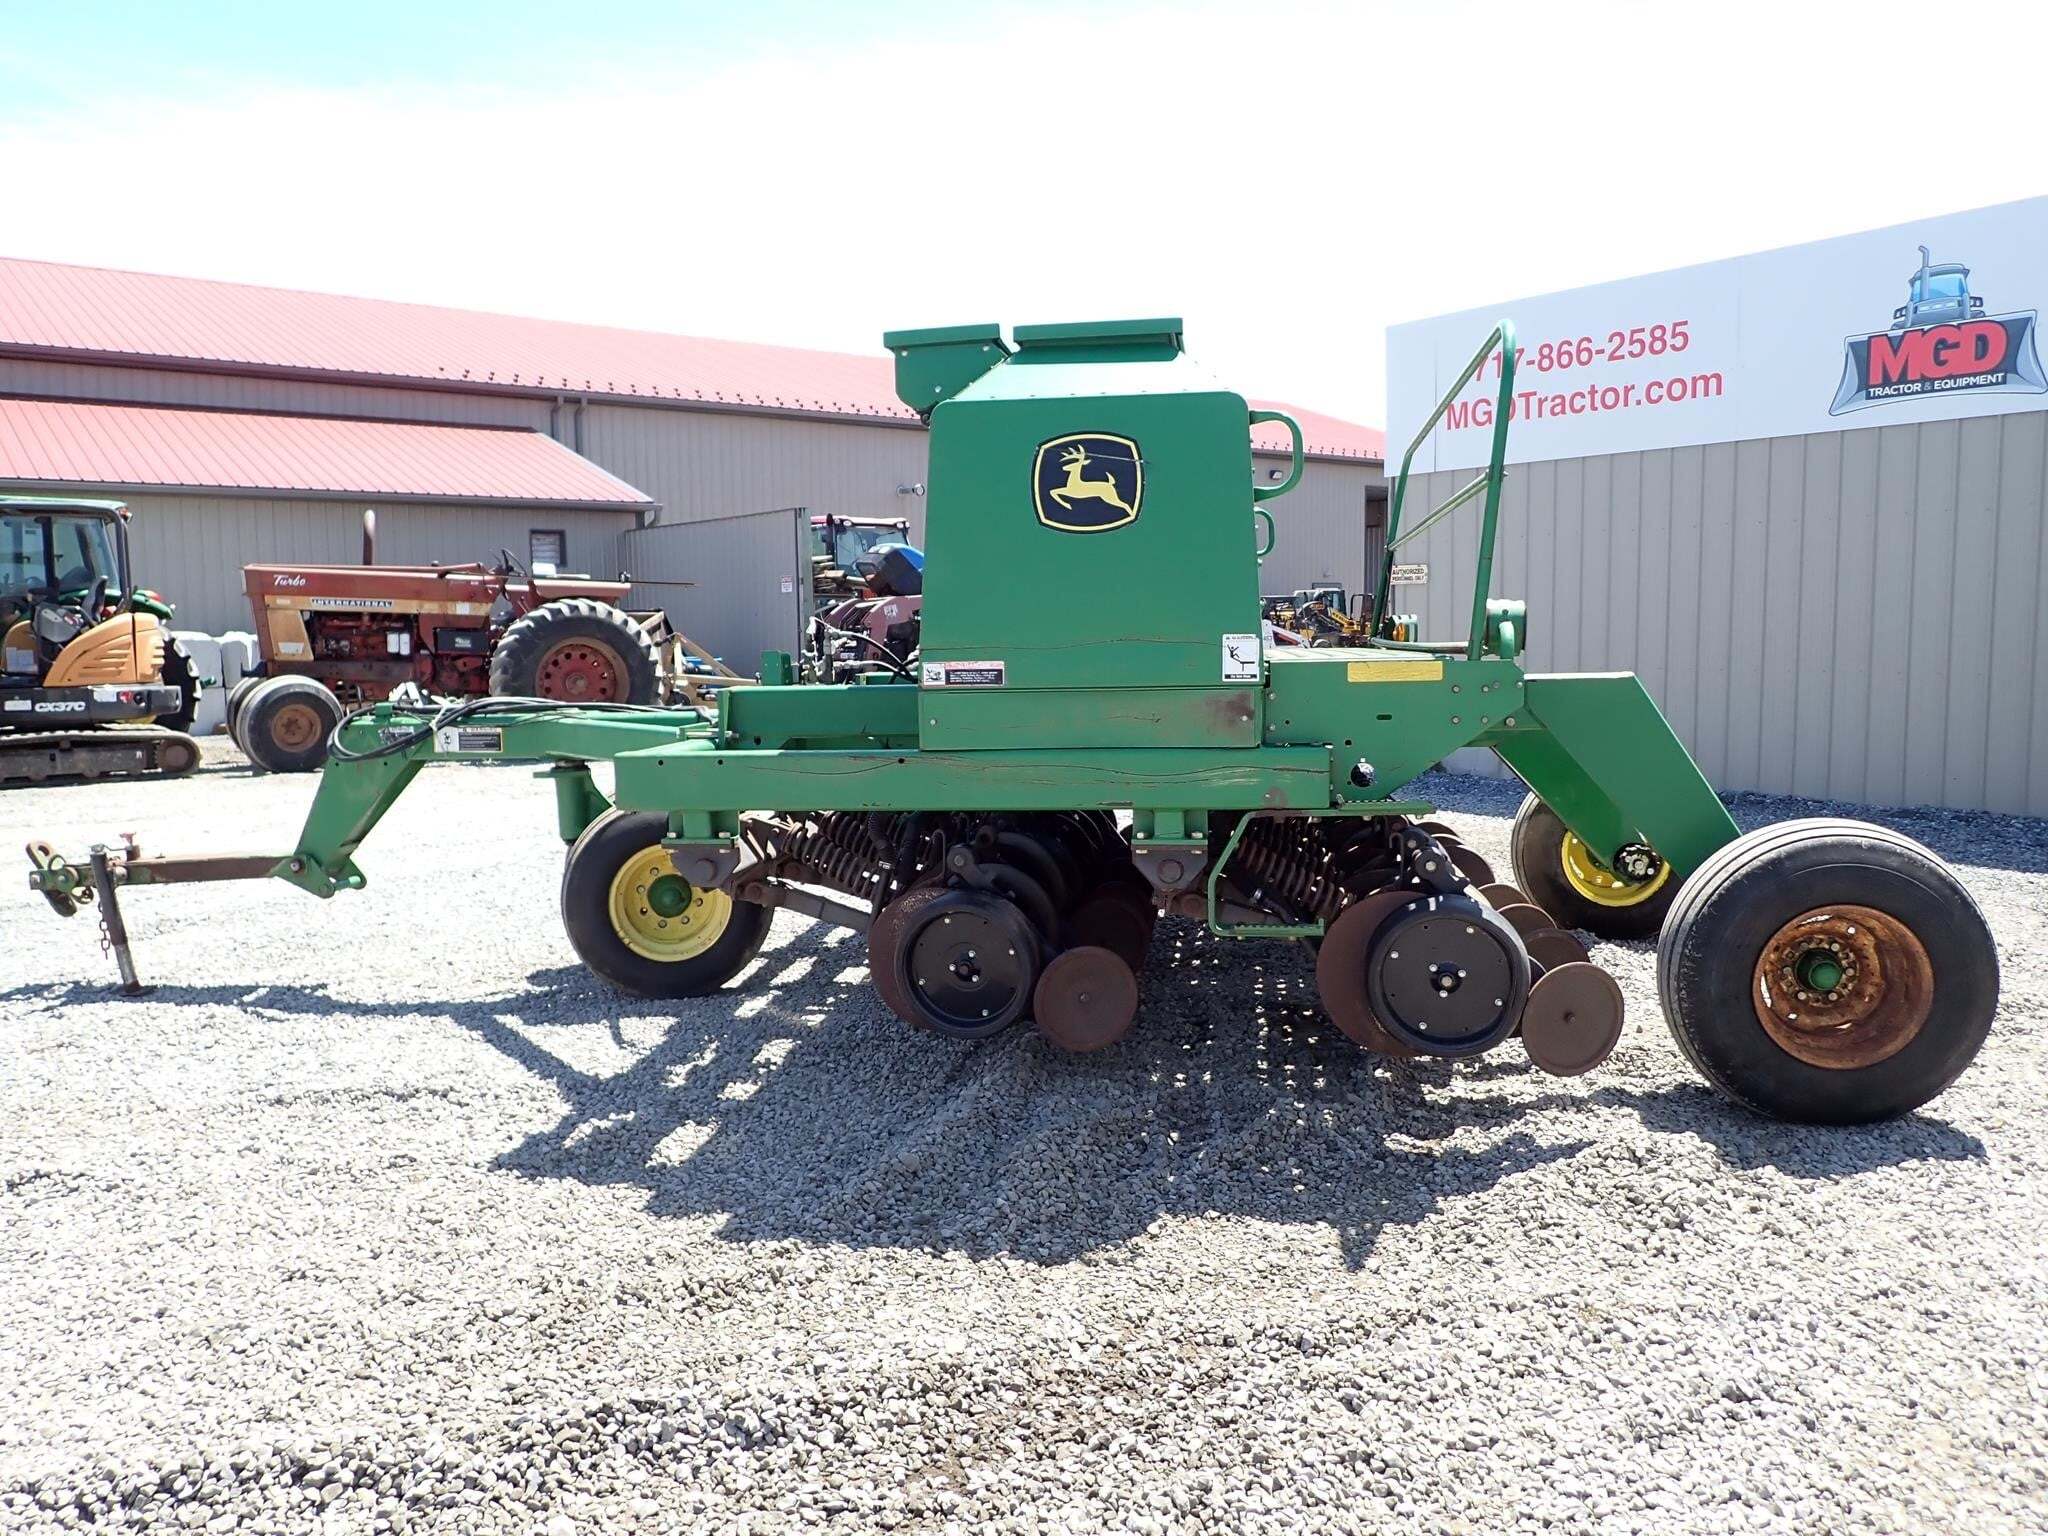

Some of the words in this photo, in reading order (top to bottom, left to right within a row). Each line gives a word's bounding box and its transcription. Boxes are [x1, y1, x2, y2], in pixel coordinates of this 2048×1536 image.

[1869, 320, 2006, 384] MGD
[1869, 382, 1922, 397] TRACTOR
[1924, 382, 1932, 390] &
[1934, 373, 2004, 390] EQUIPMENT
[273, 574, 306, 586] Turbo
[312, 599, 393, 608] INTERNATIONAL
[35, 702, 86, 712] CX37C
